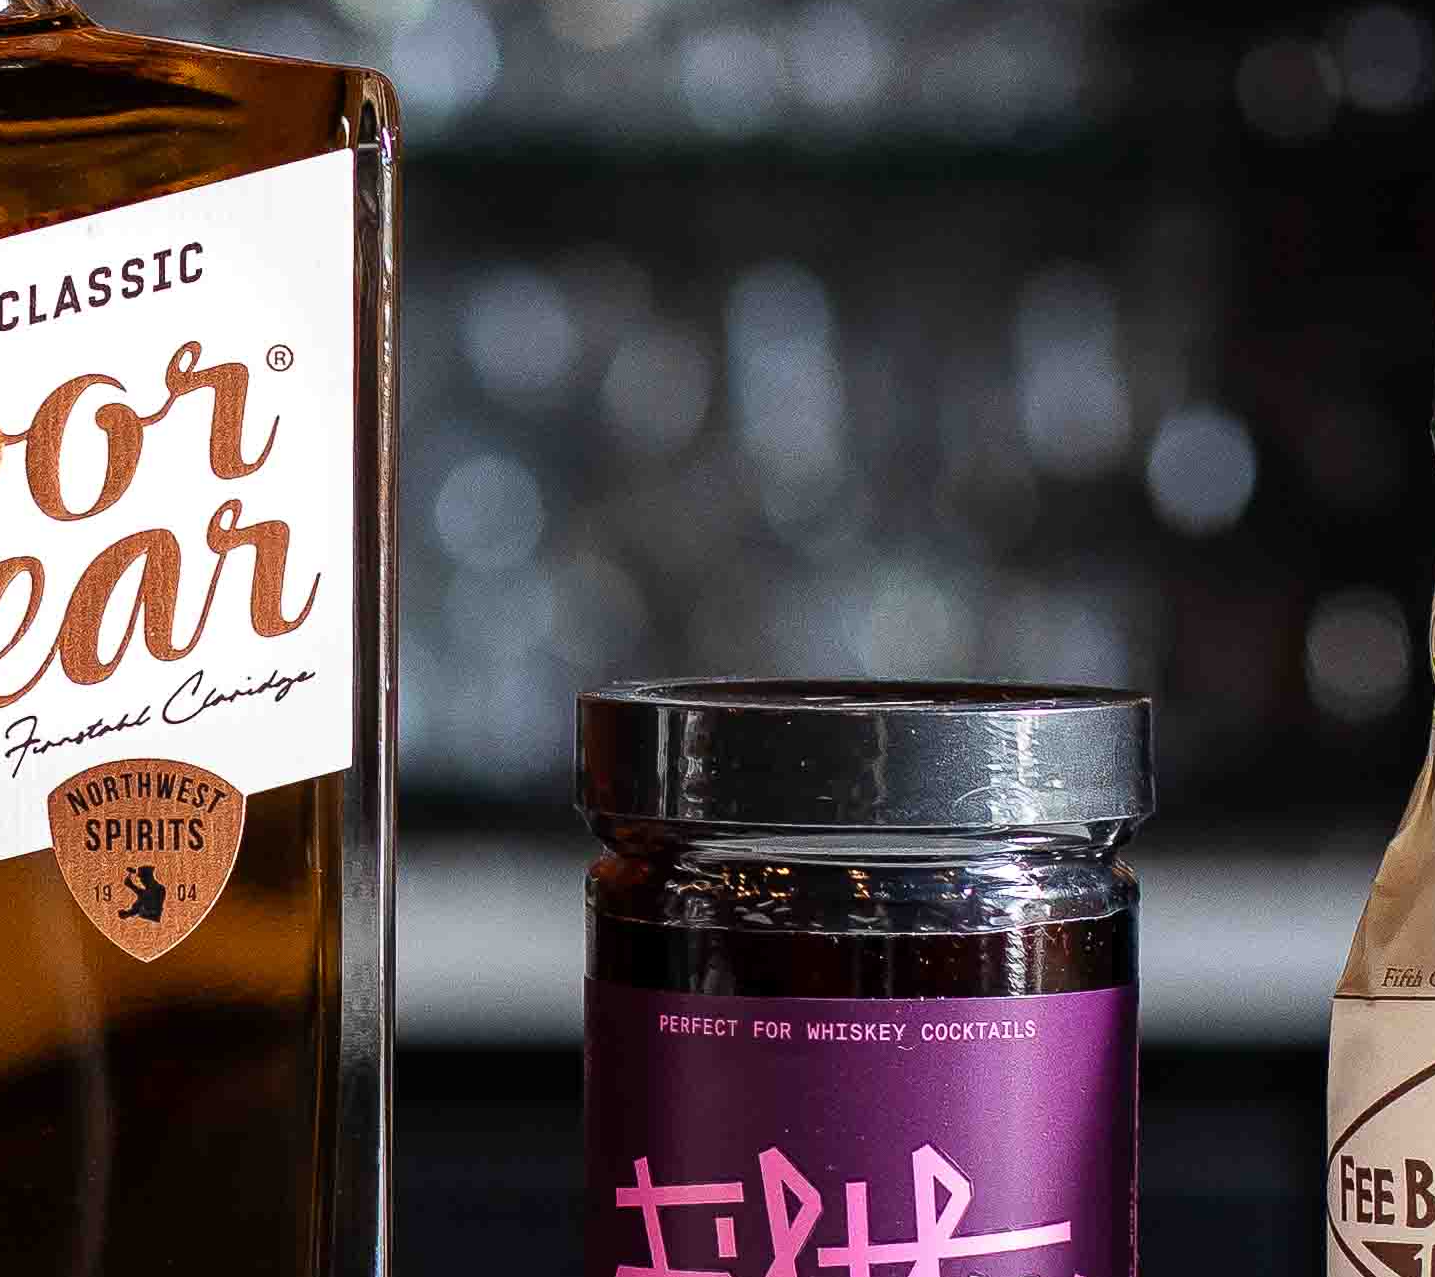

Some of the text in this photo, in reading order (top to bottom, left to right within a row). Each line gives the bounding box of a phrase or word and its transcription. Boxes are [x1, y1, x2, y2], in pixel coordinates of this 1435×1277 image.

[65, 771, 227, 815] NORTHWEST
[85, 819, 204, 853] SPIRITS
[94, 883, 198, 902] 19 04
[1381, 967, 1423, 988] Fifth
[659, 1014, 1036, 1042] PERFECT FOR WHISKEY COCKTAILS
[1339, 1155, 1395, 1225] FEE
